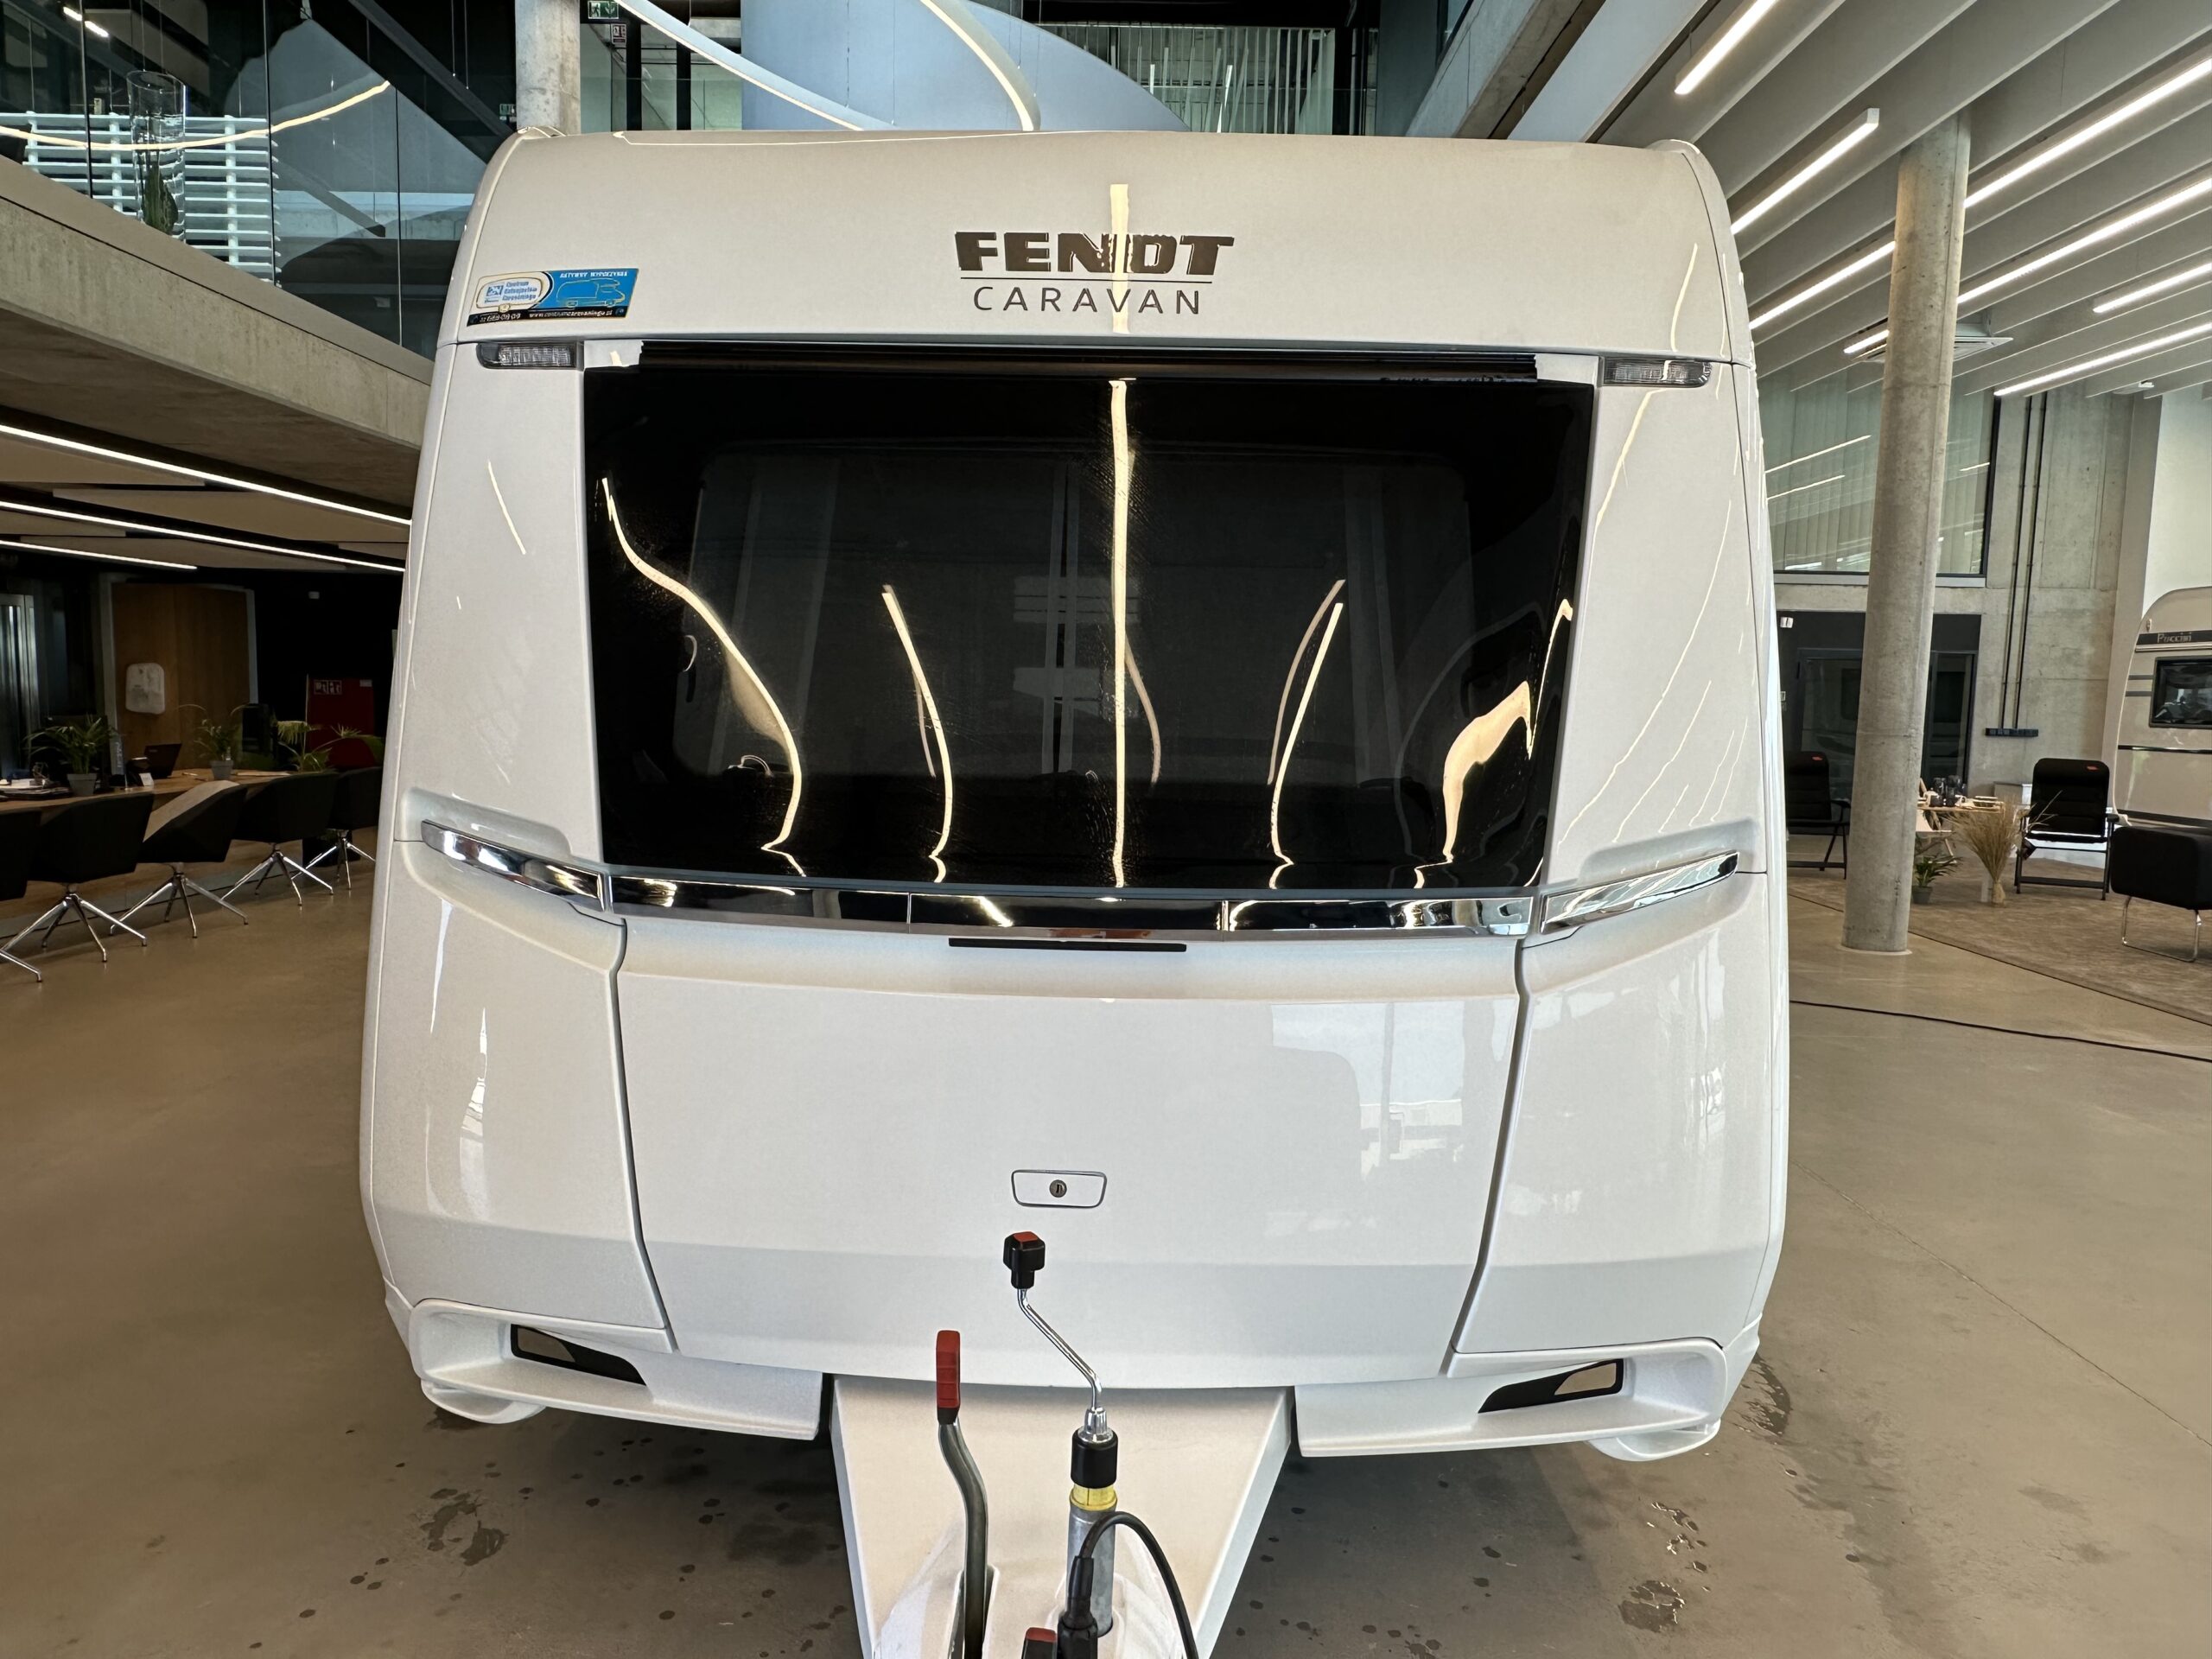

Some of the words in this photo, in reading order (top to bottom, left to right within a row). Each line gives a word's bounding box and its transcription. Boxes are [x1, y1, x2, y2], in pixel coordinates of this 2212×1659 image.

[955, 232, 1235, 276] FENDT
[973, 286, 1199, 315] CARAVAN
[2158, 632, 2192, 643] Puccini
